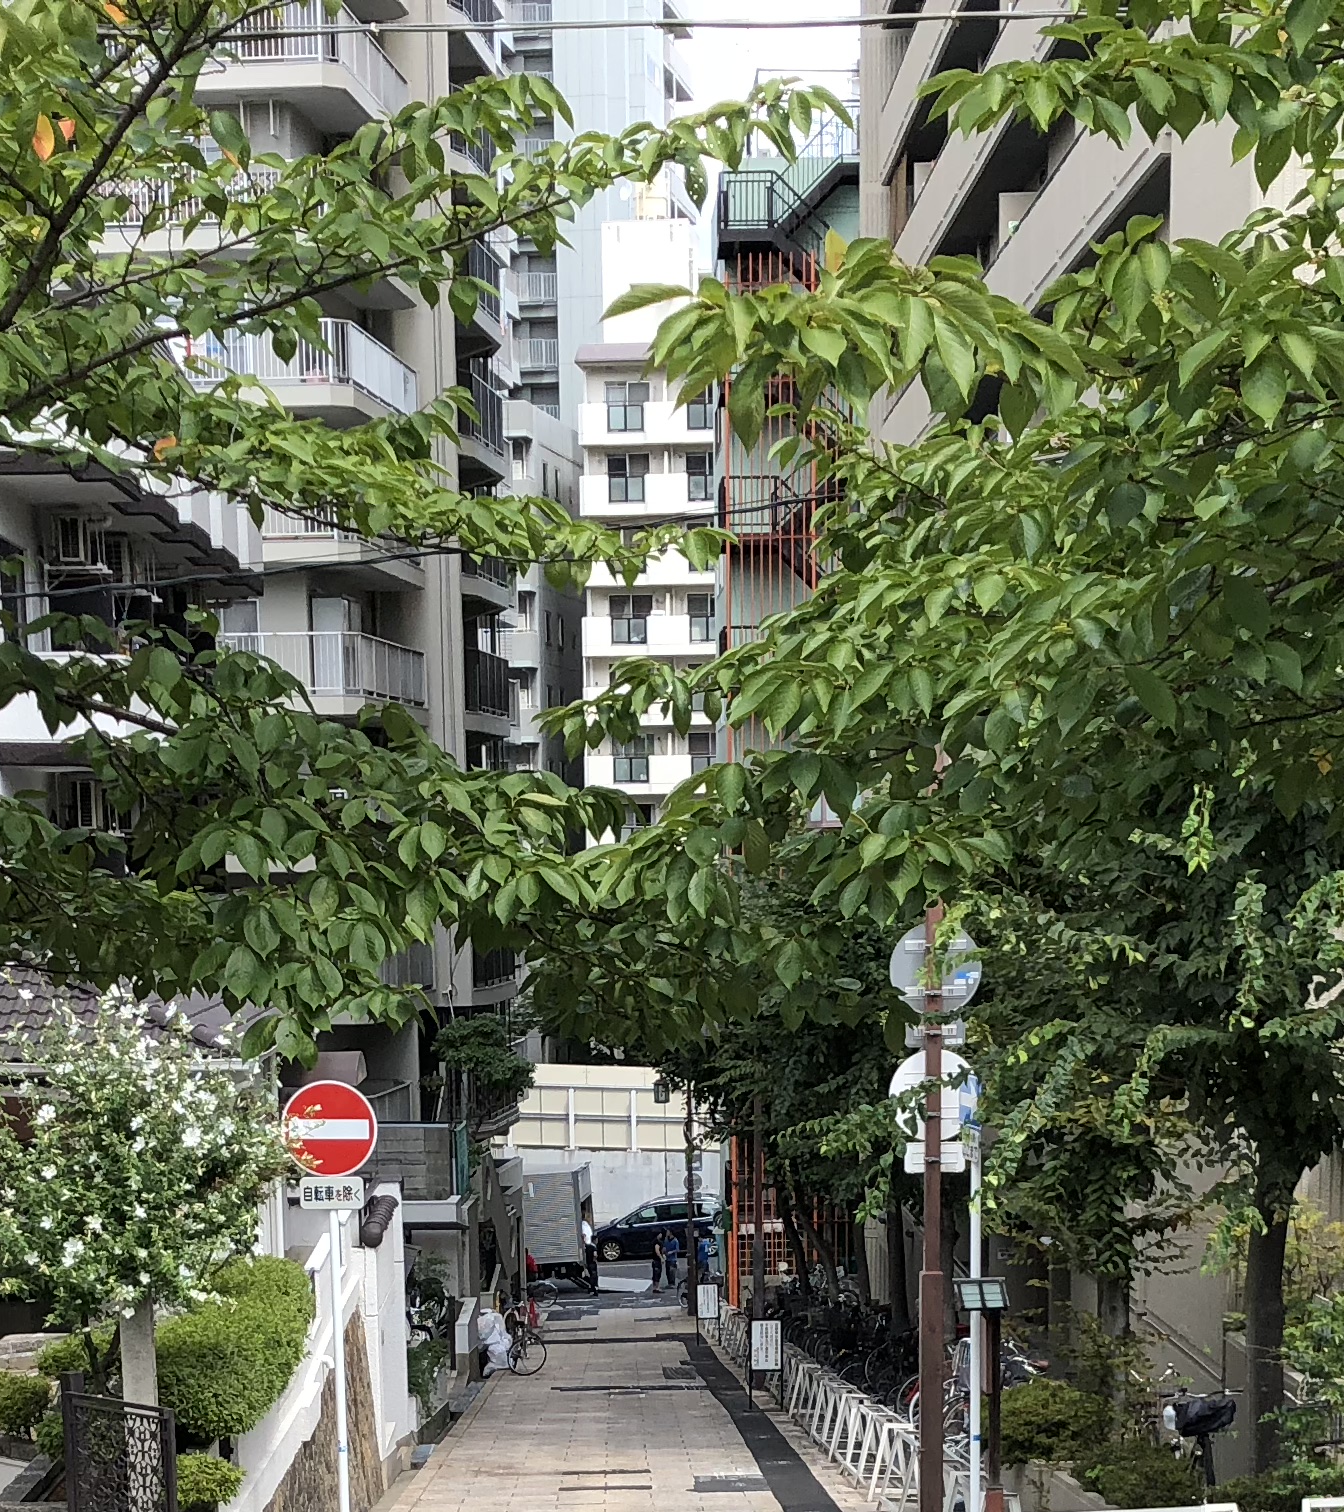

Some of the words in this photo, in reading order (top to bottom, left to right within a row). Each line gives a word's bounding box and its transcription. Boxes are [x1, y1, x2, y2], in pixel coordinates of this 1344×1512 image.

[303, 1185, 361, 1202] 自転車を除く
